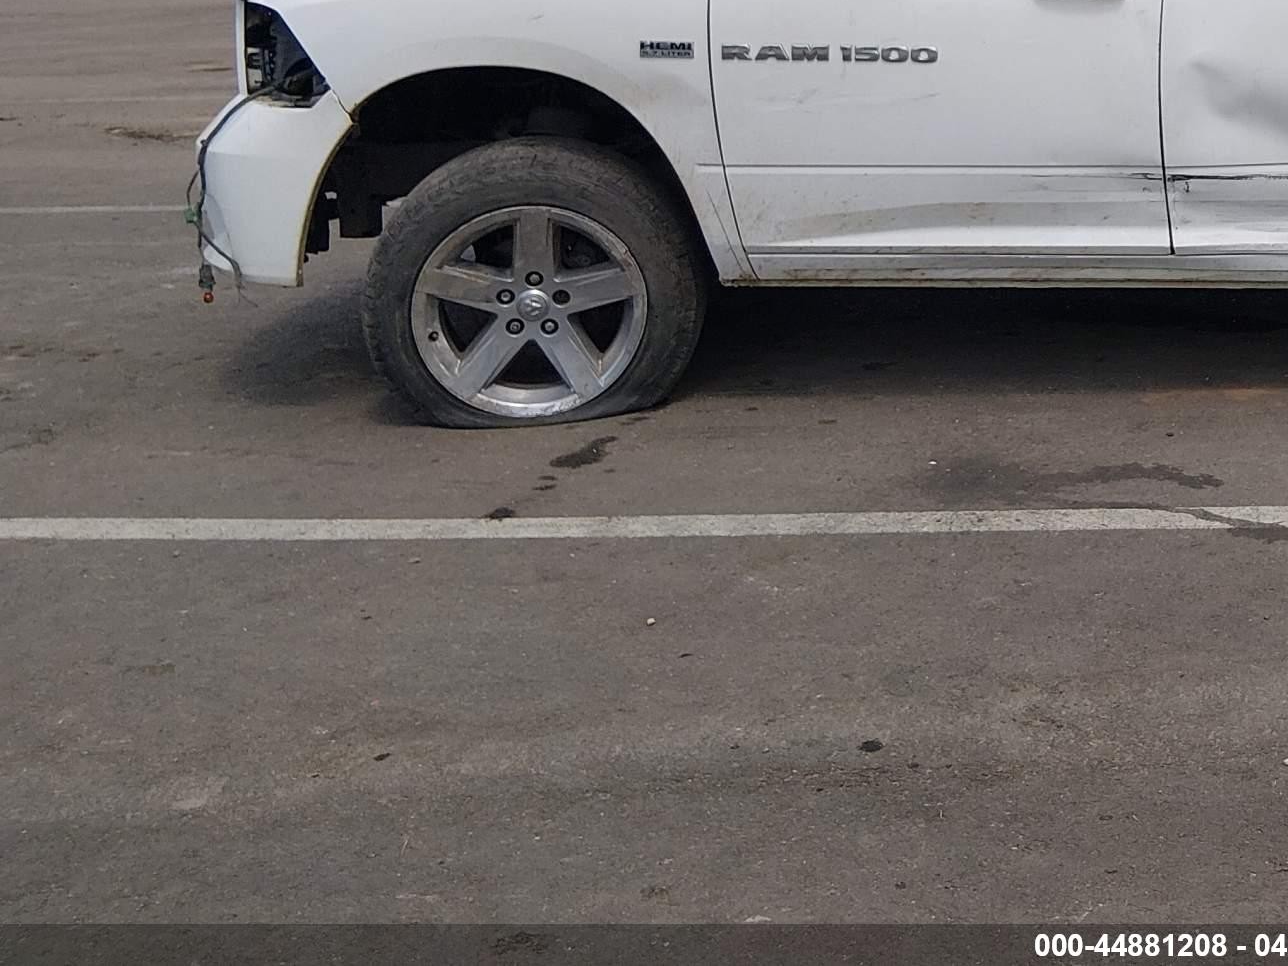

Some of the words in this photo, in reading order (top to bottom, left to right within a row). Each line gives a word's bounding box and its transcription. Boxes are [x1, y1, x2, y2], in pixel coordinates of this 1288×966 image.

[640, 41, 692, 50] HEMI
[721, 43, 830, 61] RAM
[840, 45, 939, 63] 1500
